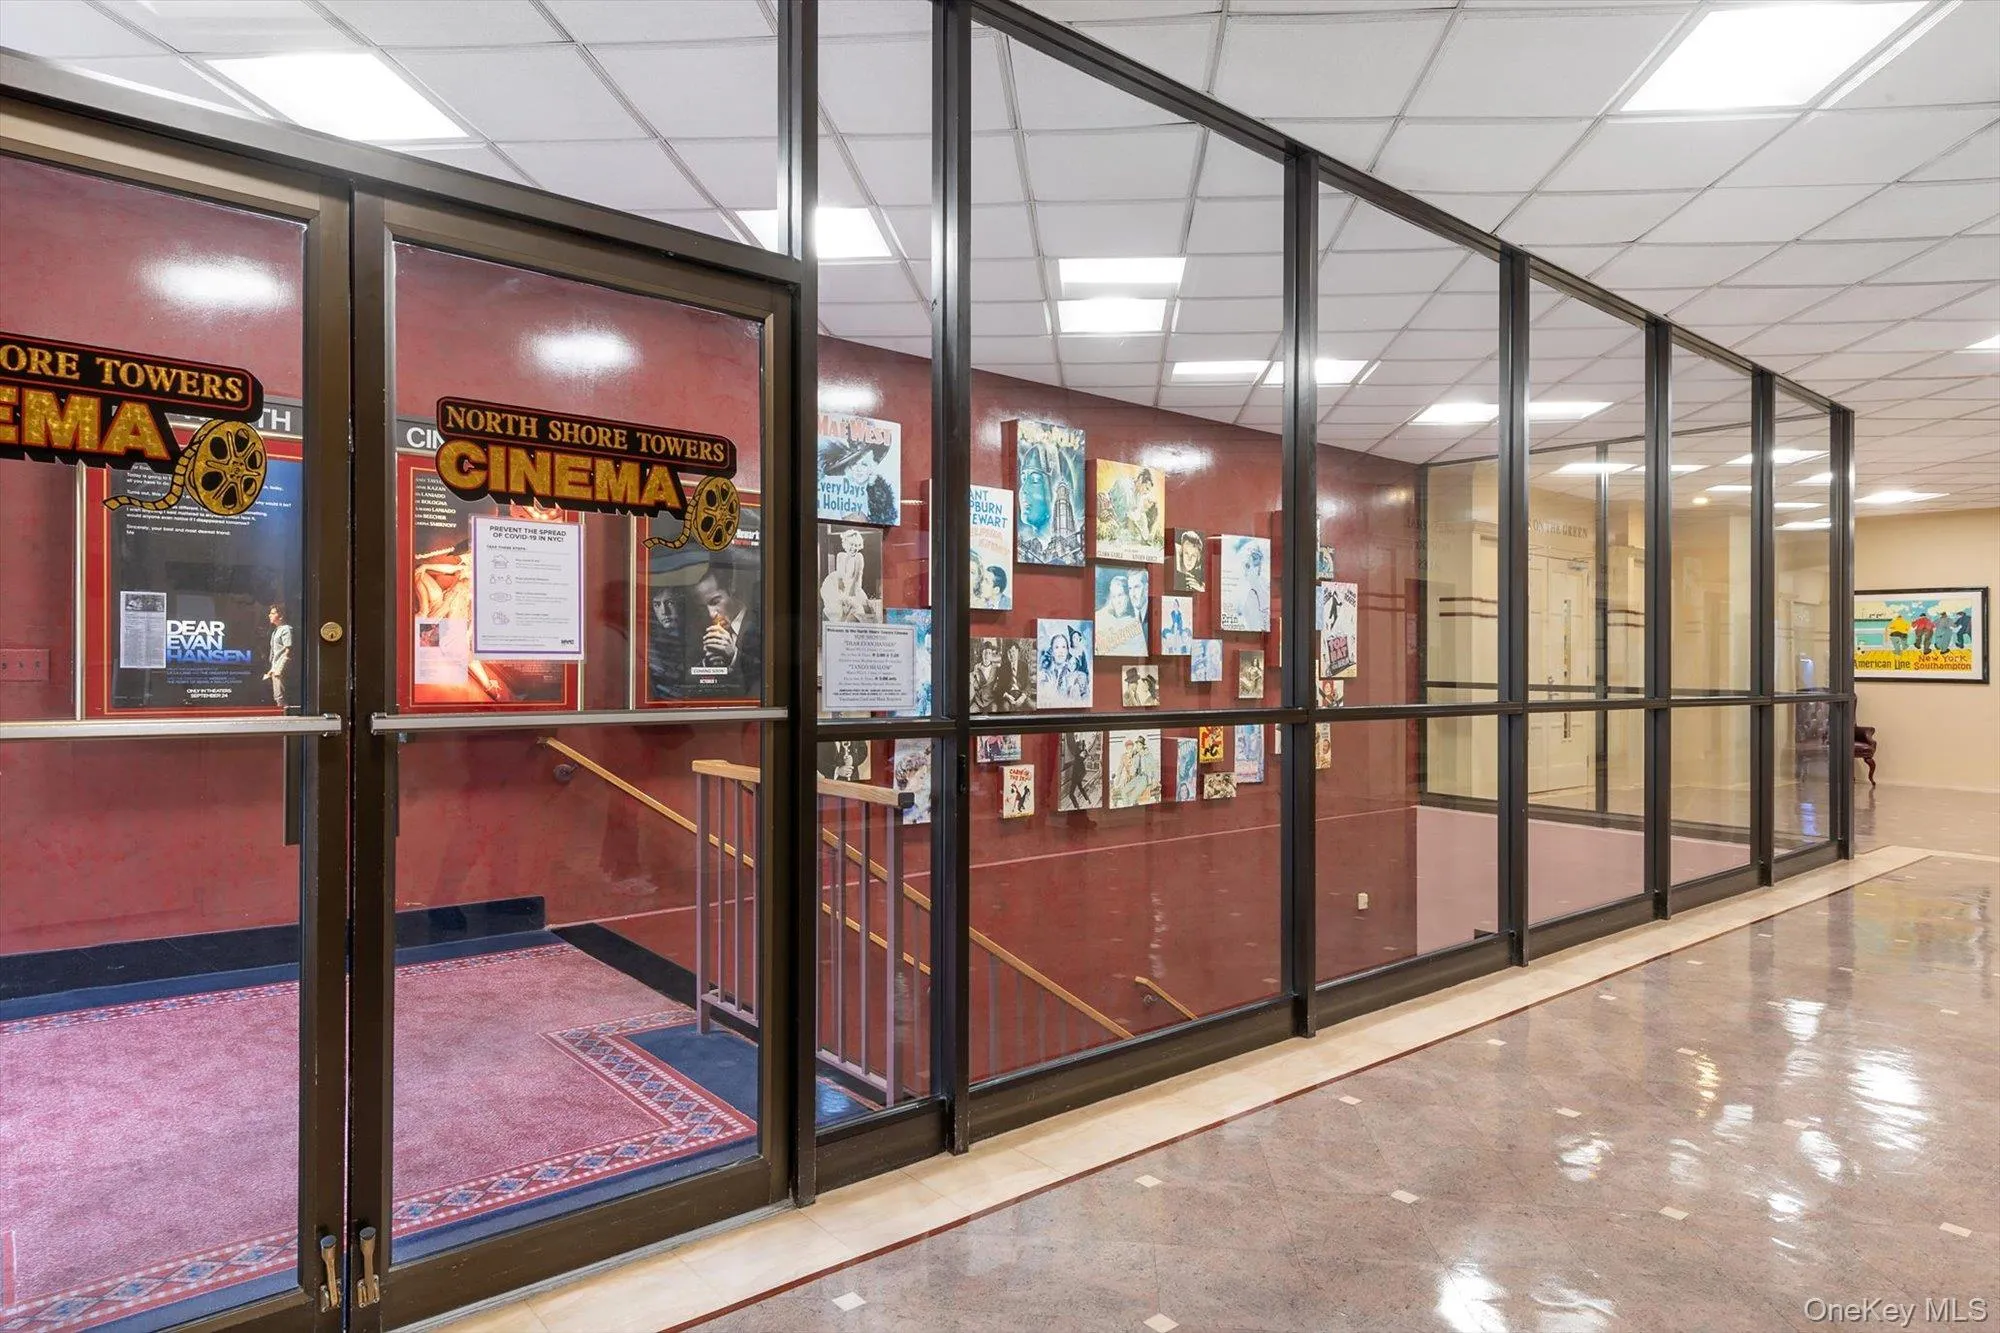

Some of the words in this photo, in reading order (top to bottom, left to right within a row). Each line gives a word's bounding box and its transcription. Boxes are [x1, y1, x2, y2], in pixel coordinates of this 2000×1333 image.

[0, 344, 80, 380] ORE
[96, 357, 244, 402] TOWERS
[446, 405, 538, 439] NORTH
[548, 420, 628, 450] SHORE
[636, 432, 725, 463] TOWERS
[438, 440, 682, 510] CINEMA
[817, 482, 840, 495] very
[843, 478, 865, 497] Days
[970, 490, 988, 501] ANT
[823, 495, 862, 512] Holiday
[970, 501, 1003, 516] PBURN
[971, 514, 1008, 529] EWART
[489, 525, 522, 533] PREVENT
[539, 529, 567, 537] SPREAD
[504, 533, 537, 541] COVID-19
[166, 620, 225, 636] DEAR
[166, 634, 223, 650] EVAN
[166, 649, 252, 663] HANSEN
[1918, 654, 1938, 662] New
[1942, 654, 1967, 662] York
[1894, 659, 1910, 670] Line
[1913, 662, 1971, 670] Southampton
